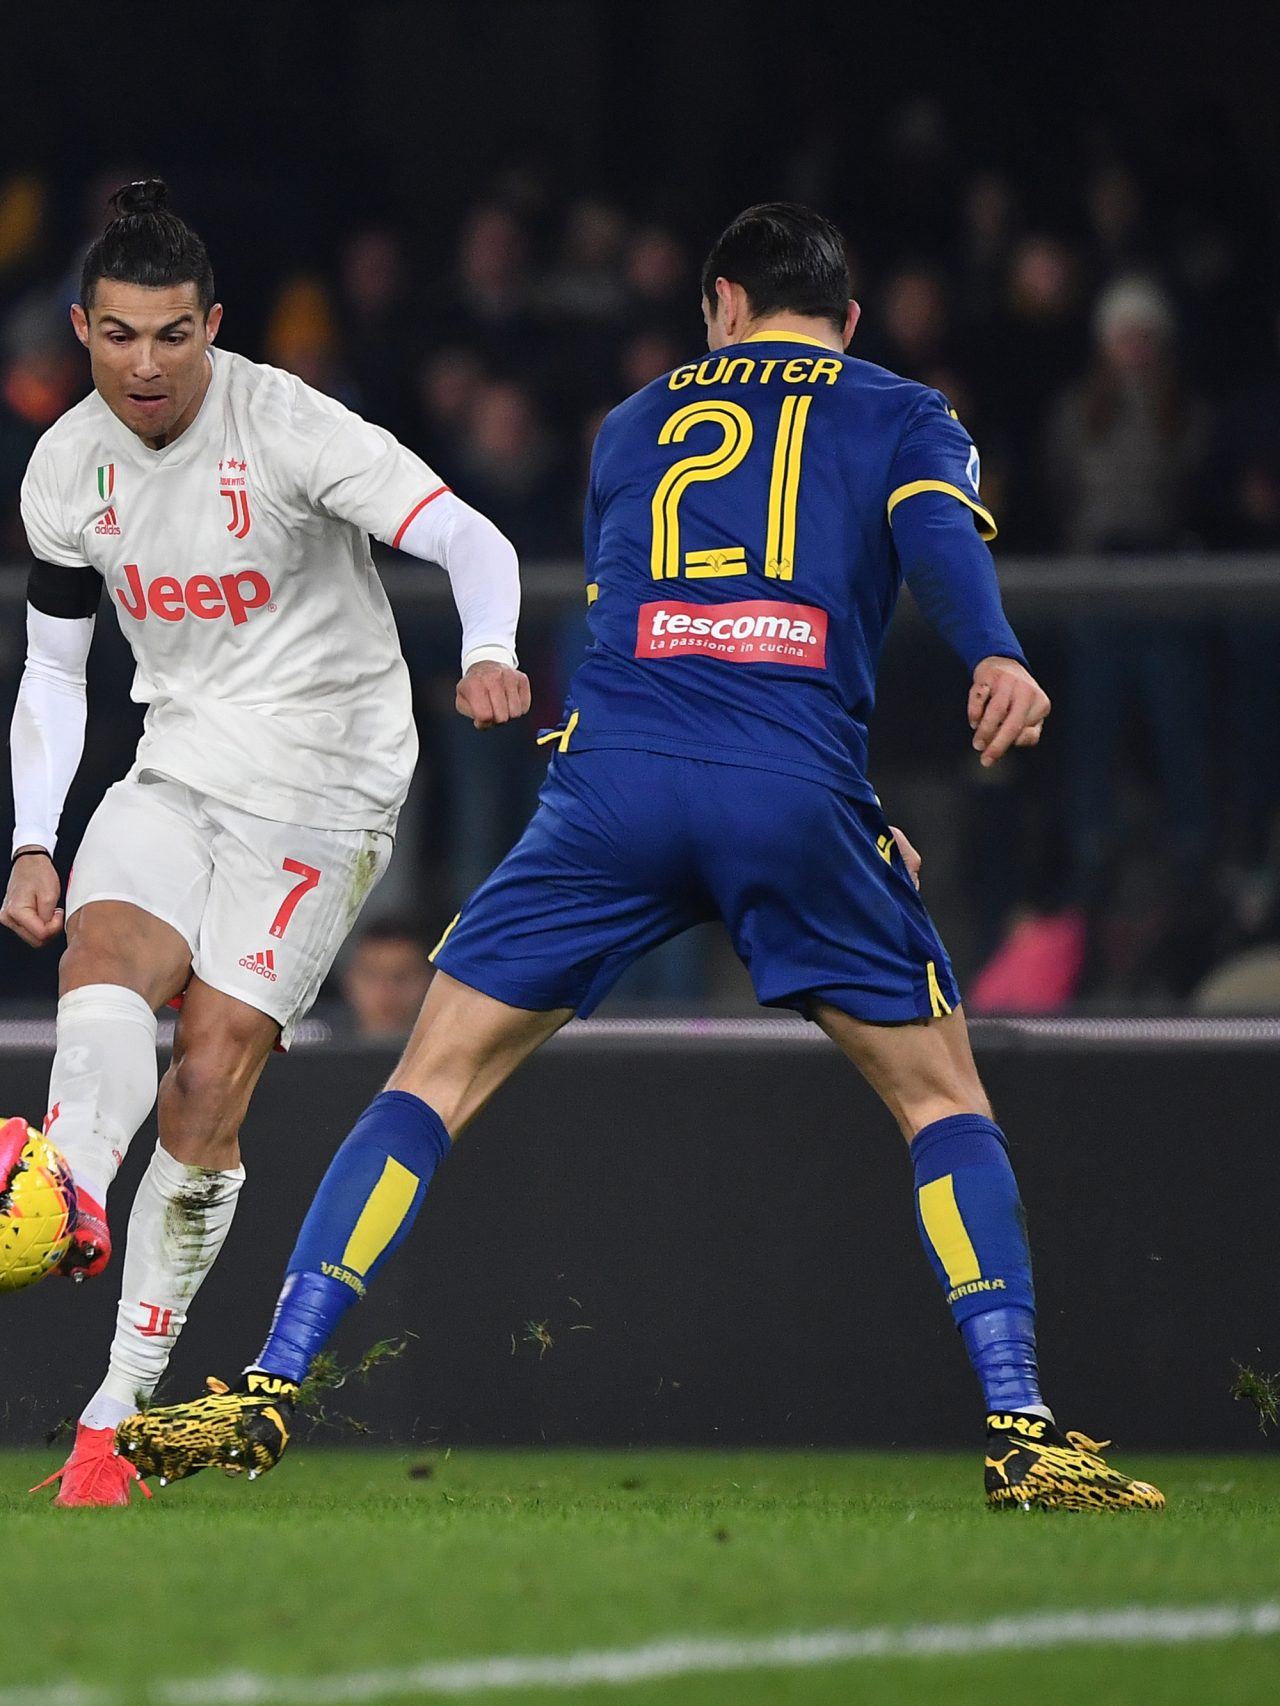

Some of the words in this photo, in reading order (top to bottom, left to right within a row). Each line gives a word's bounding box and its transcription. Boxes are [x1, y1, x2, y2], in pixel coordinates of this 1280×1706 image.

[650, 395, 813, 581] 21
[116, 564, 271, 627] Jeep
[650, 640, 665, 651] La
[670, 636, 736, 653] passione
[740, 642, 754, 653] in
[759, 642, 808, 659] cucina.
[269, 857, 321, 939] 7
[238, 958, 278, 982] adidas
